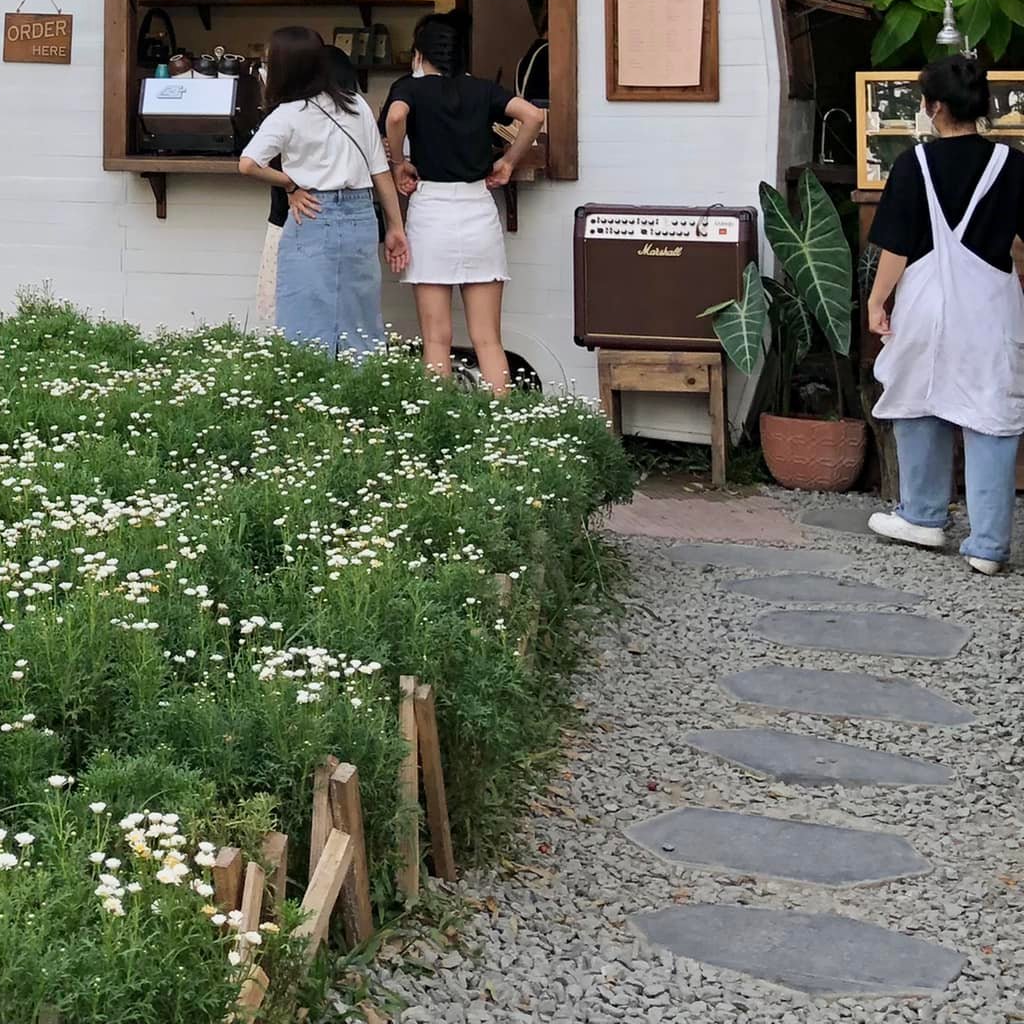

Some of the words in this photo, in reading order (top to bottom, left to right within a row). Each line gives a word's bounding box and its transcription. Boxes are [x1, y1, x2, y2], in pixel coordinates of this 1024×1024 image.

[7, 20, 67, 42] ORDER
[32, 45, 67, 57] HERE
[637, 242, 683, 257] Marshall
